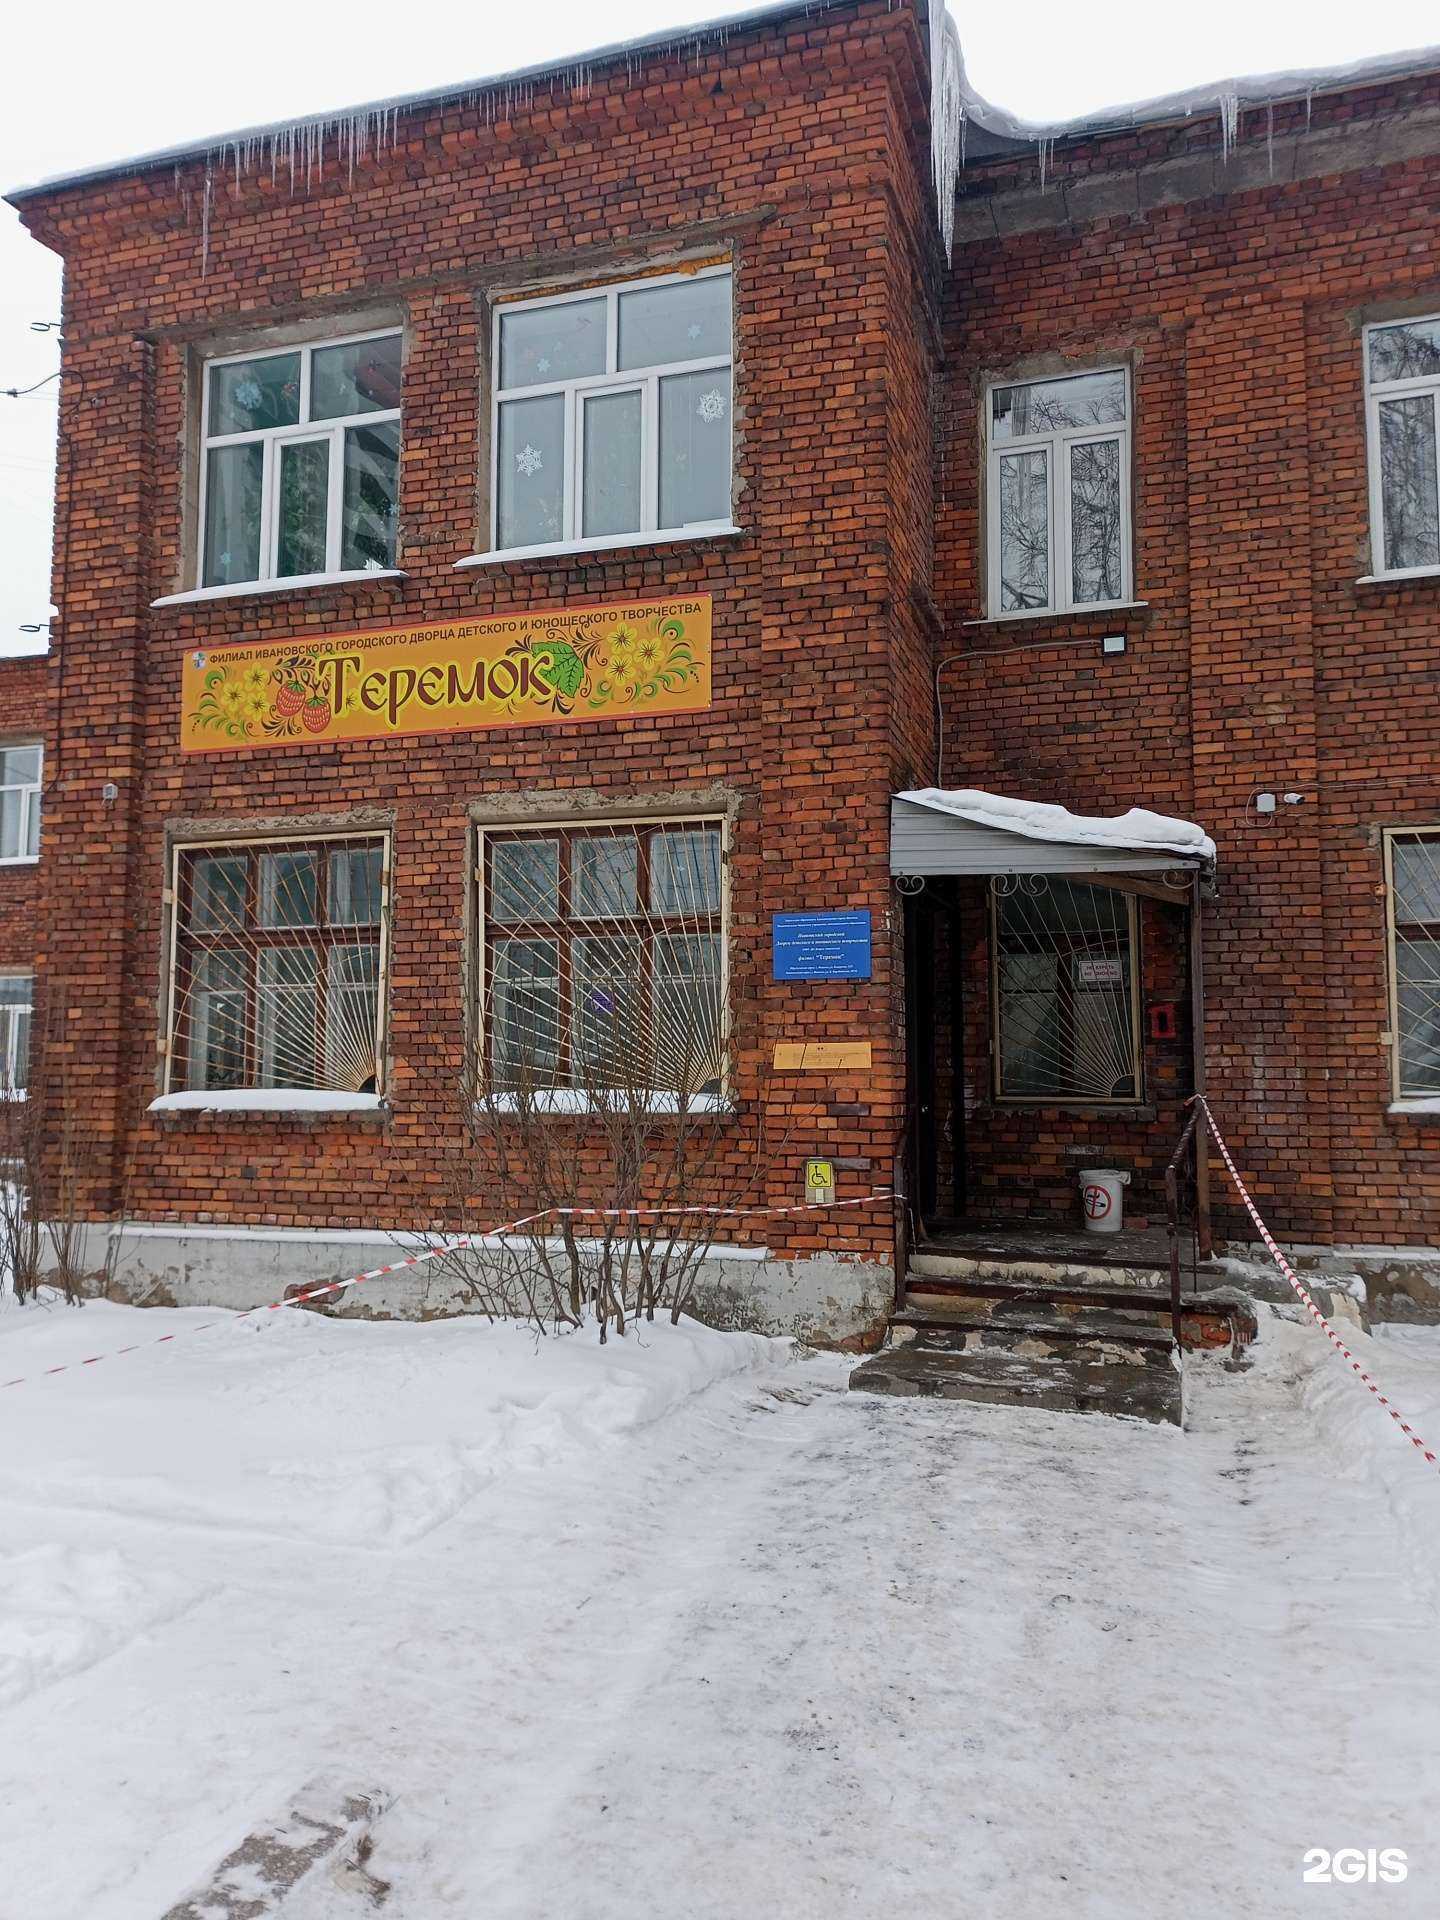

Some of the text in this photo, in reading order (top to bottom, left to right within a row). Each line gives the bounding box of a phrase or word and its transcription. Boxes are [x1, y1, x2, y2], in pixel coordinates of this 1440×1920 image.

[210, 648, 252, 664] ФИЛИАЛ
[255, 641, 333, 659] ИВАНОВСКОГО
[336, 634, 407, 651] ГОРОДСКОГО
[409, 628, 455, 644] ДВОРЦА
[457, 622, 517, 639] ДЕТСКОГО
[520, 620, 528, 631] И
[622, 602, 702, 621] ТВОРЧЕСТВА
[318, 656, 552, 725] Теремок
